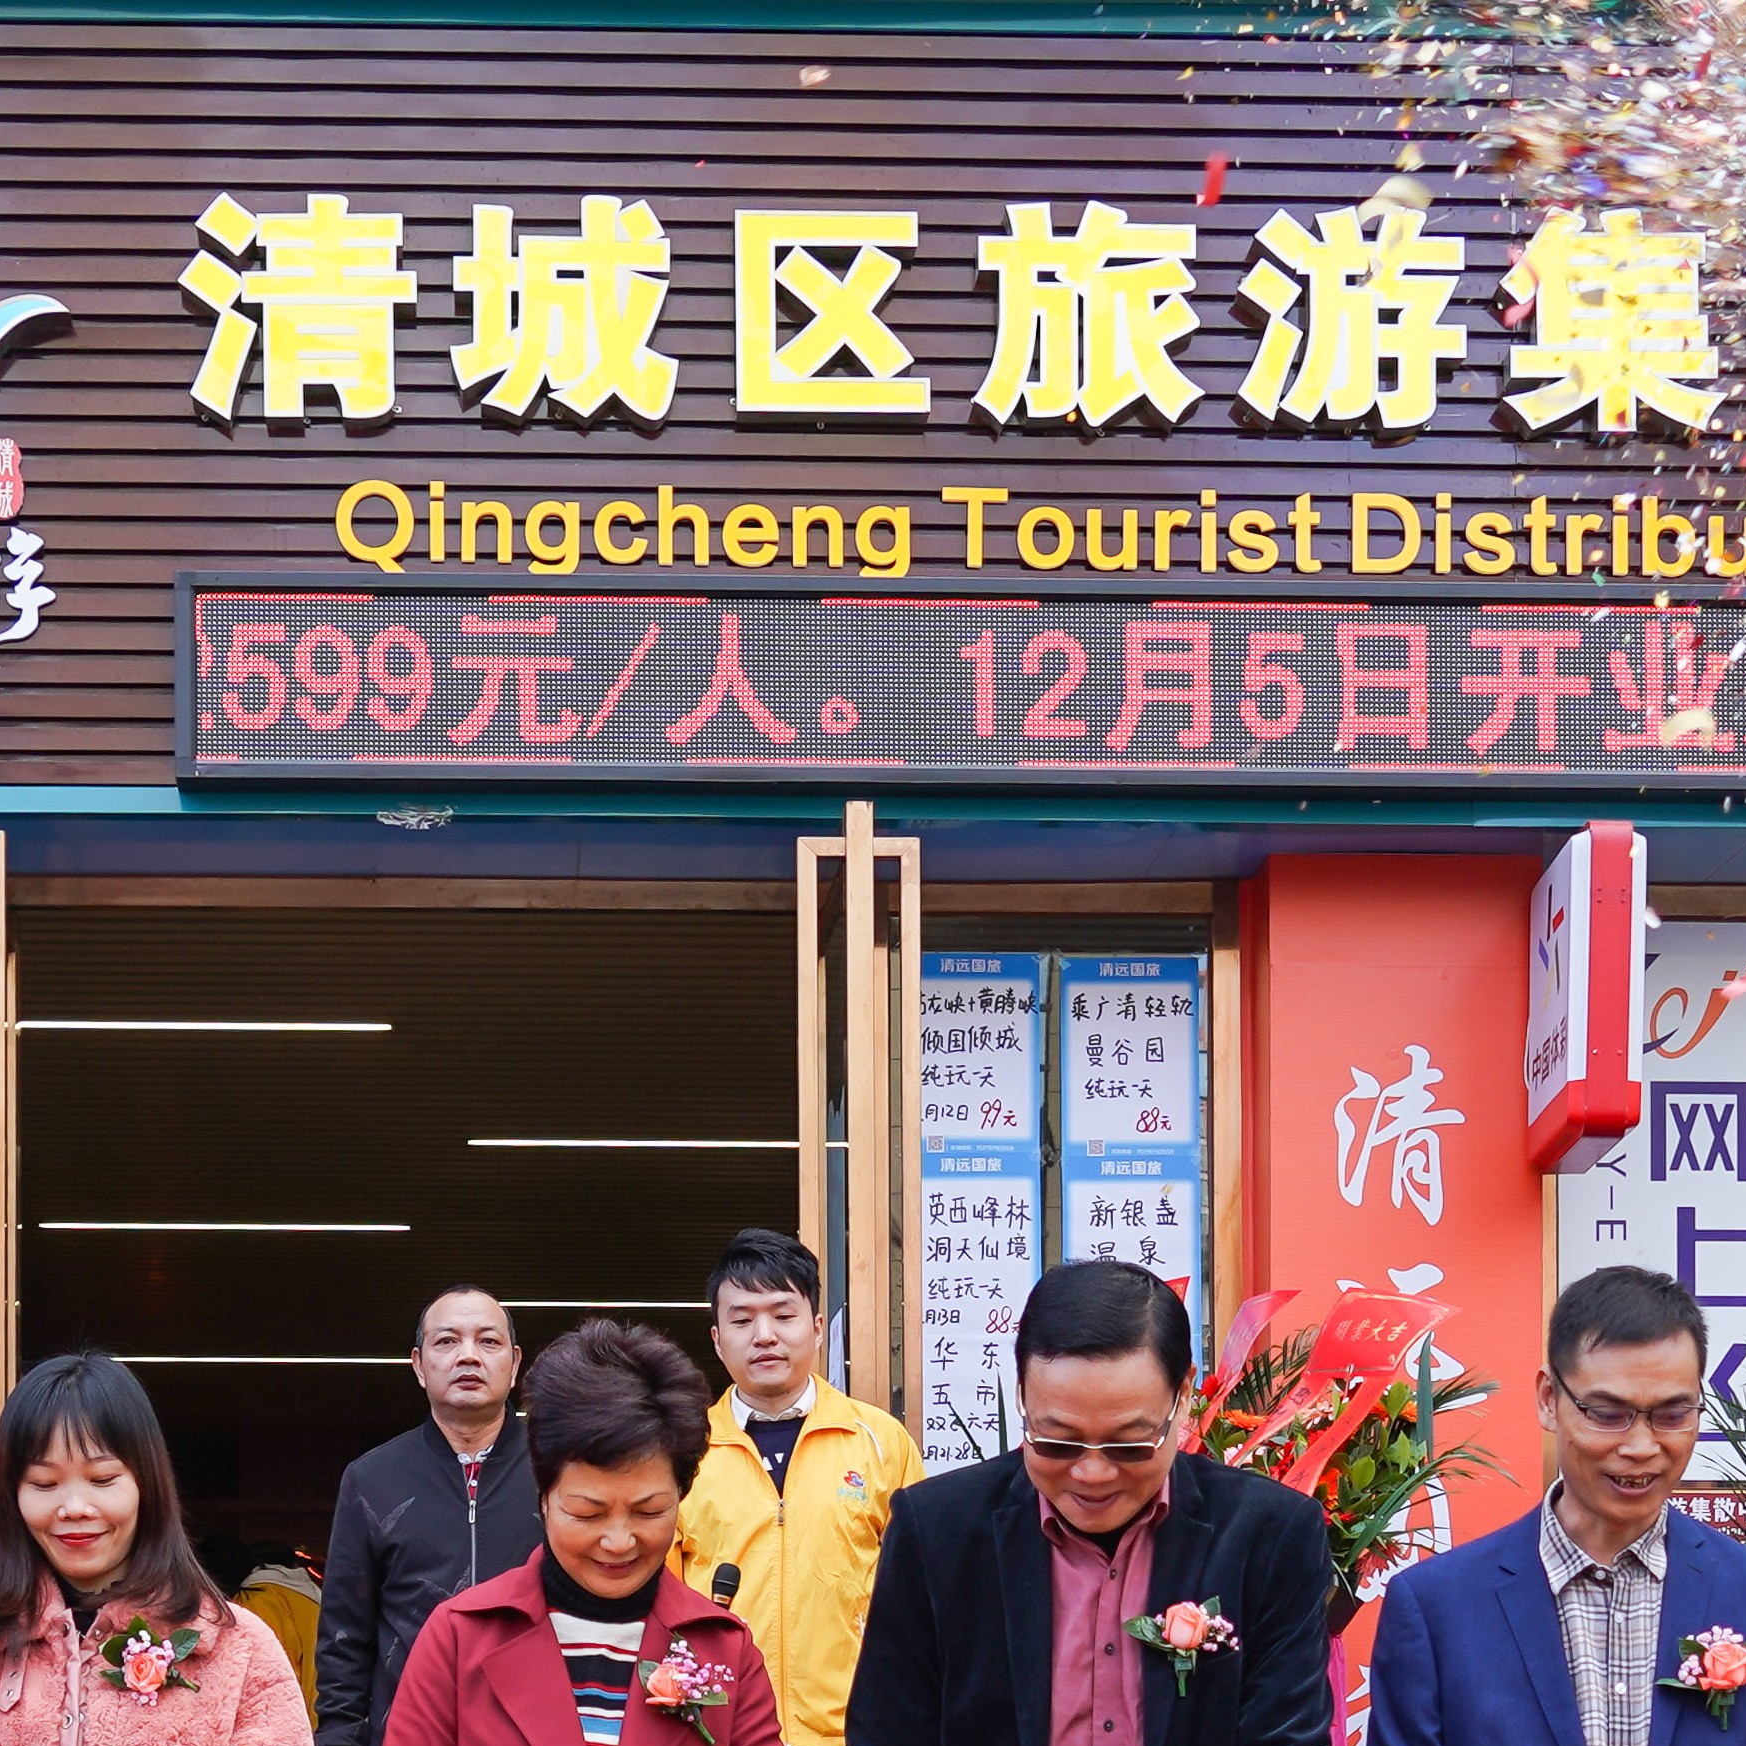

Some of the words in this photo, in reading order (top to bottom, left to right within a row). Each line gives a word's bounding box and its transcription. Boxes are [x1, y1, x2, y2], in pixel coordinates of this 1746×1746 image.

[335, 479, 913, 578] Qingcheng
[941, 484, 1322, 574] Tourist
[939, 958, 1002, 974] 清远国旅
[1098, 961, 1161, 977] 清远国旅
[921, 1102, 969, 1123] 月12日
[922, 1308, 961, 1326] 月13日
